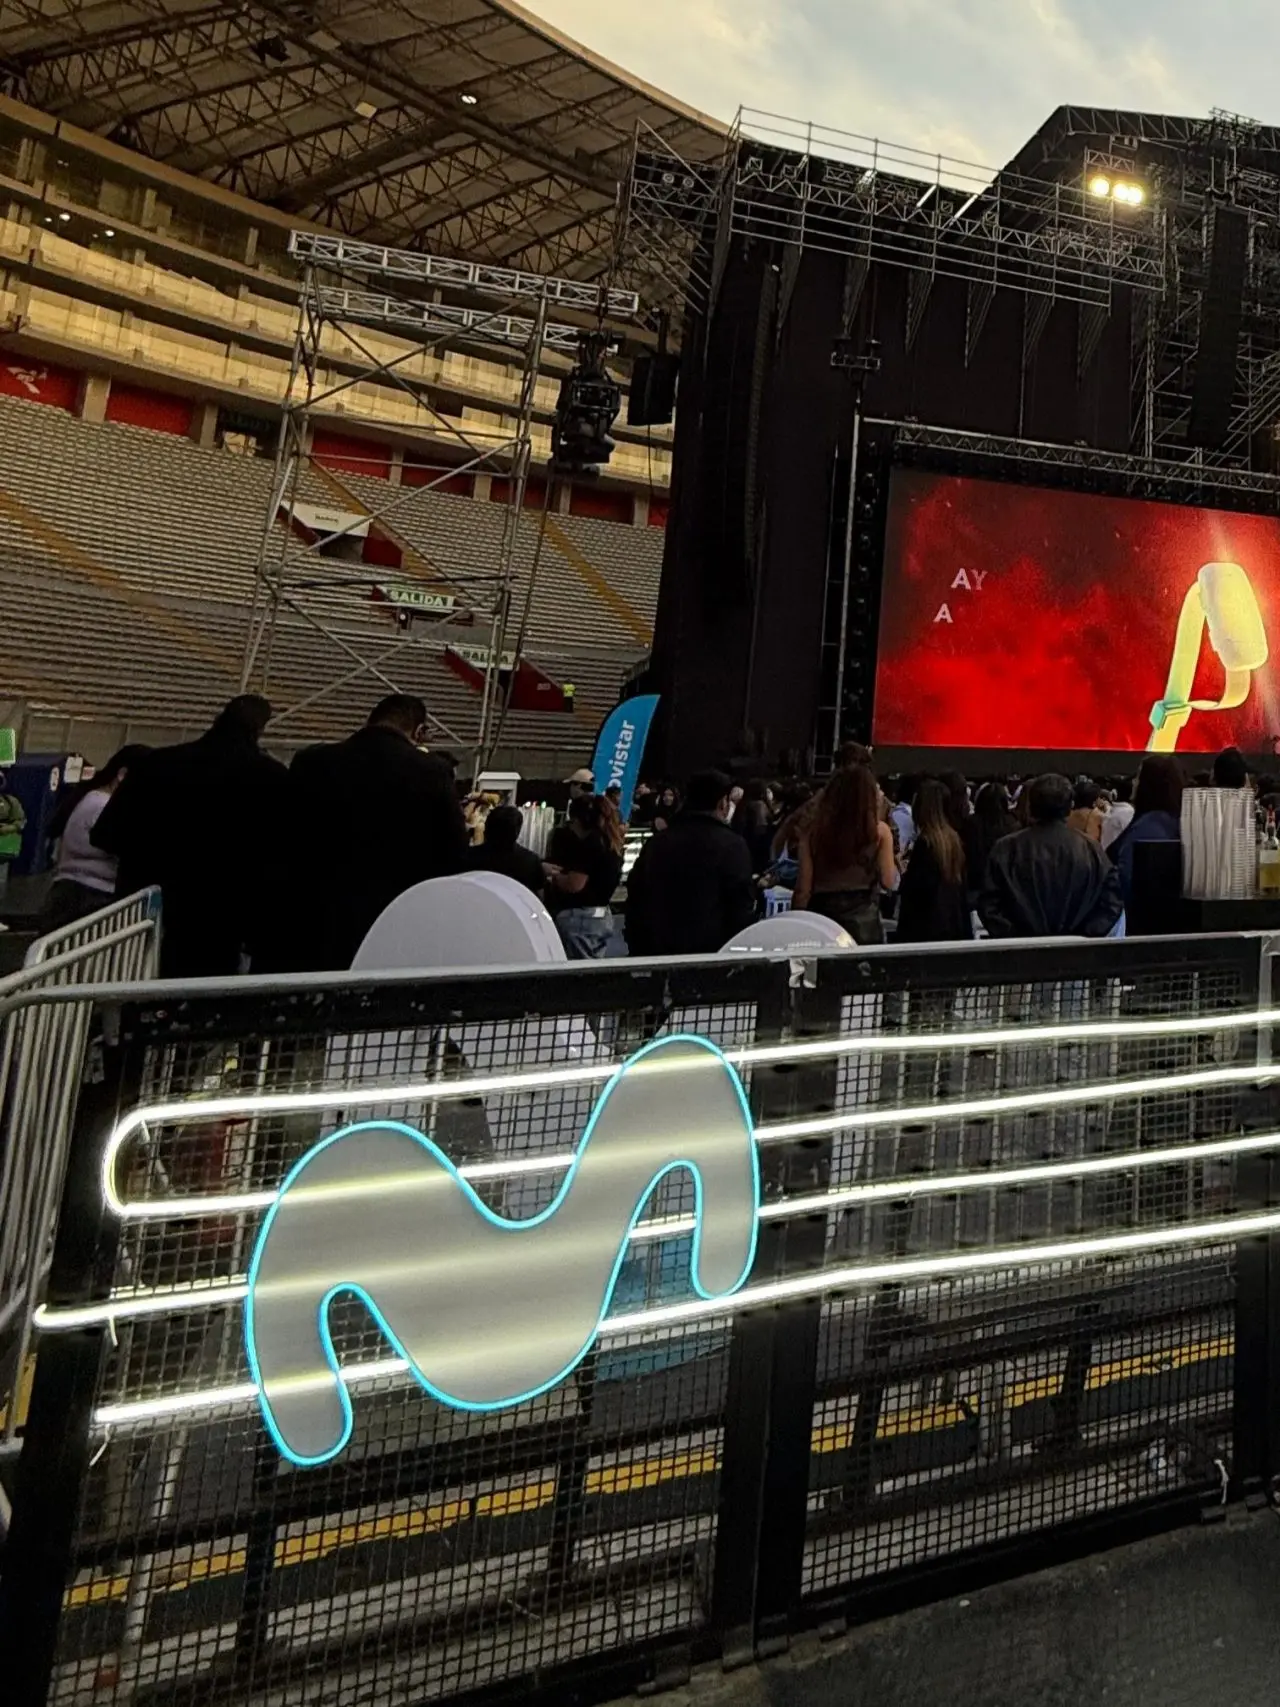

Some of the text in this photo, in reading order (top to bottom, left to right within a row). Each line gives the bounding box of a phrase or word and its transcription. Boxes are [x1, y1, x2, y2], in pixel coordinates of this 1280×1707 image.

[951, 568, 988, 591] AY
[389, 590, 444, 607] SALIDA
[934, 603, 953, 623] A
[608, 719, 635, 789] ovistar
